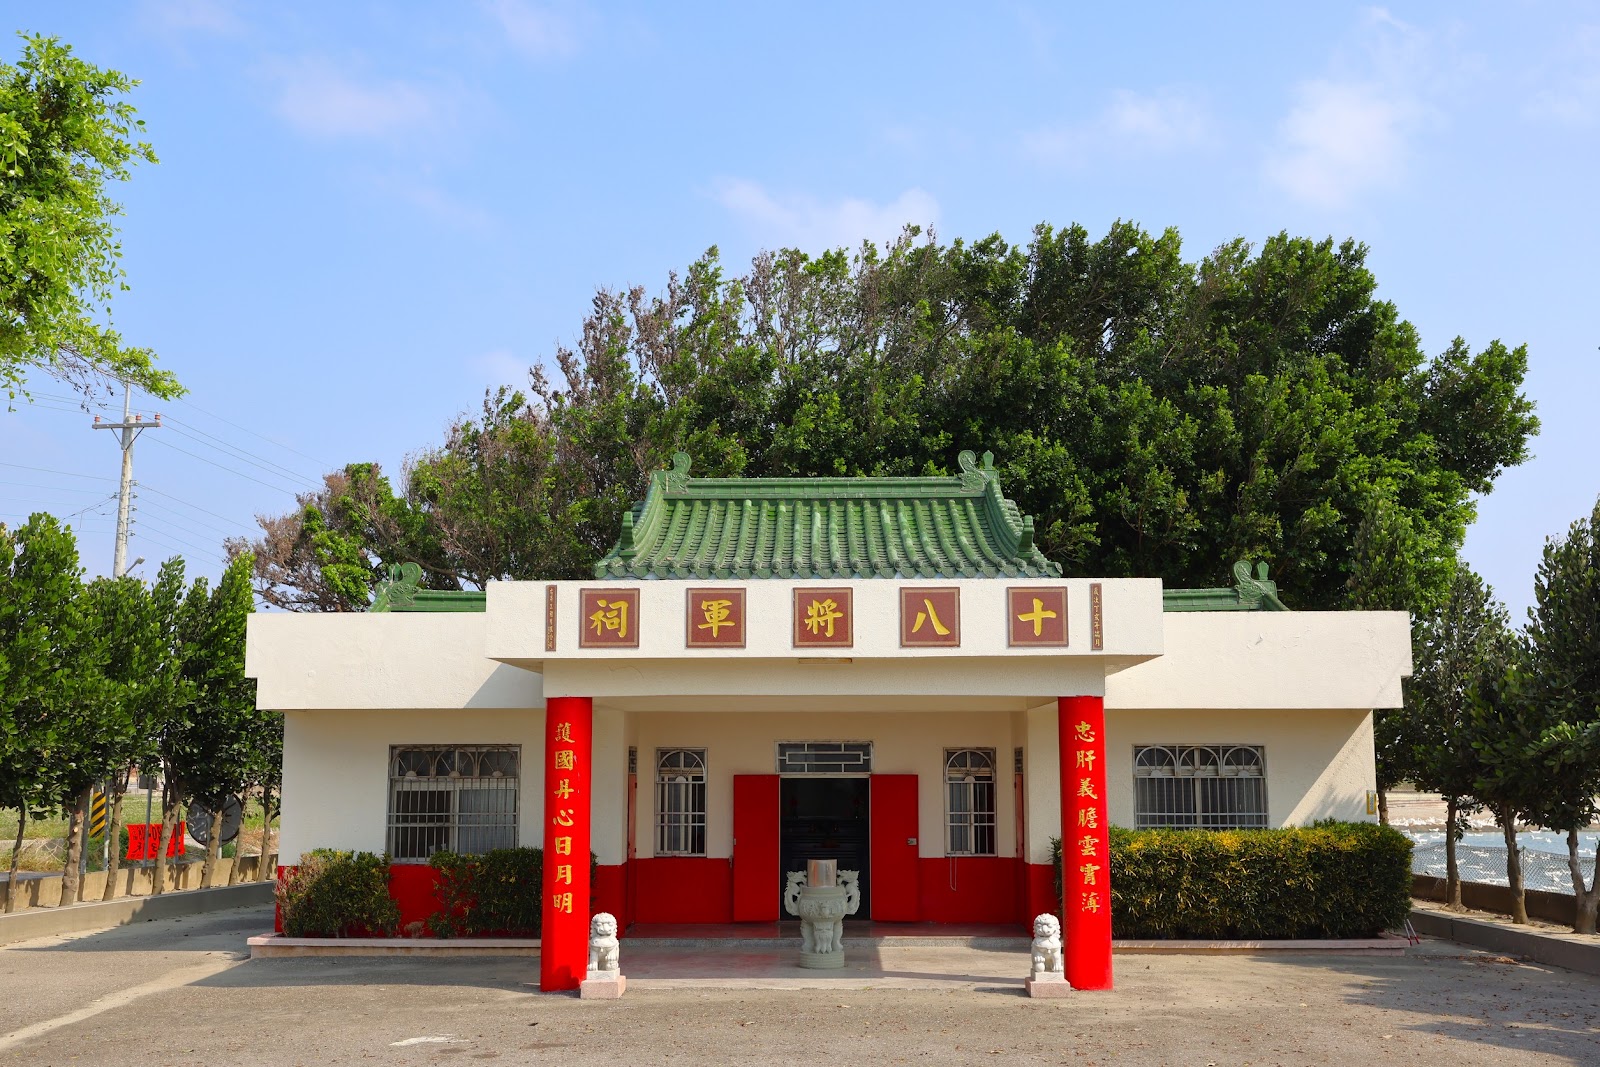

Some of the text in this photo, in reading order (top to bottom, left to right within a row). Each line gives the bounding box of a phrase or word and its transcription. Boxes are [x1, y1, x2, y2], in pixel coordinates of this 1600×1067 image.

[553, 722, 575, 914] 護國丹心日月明
